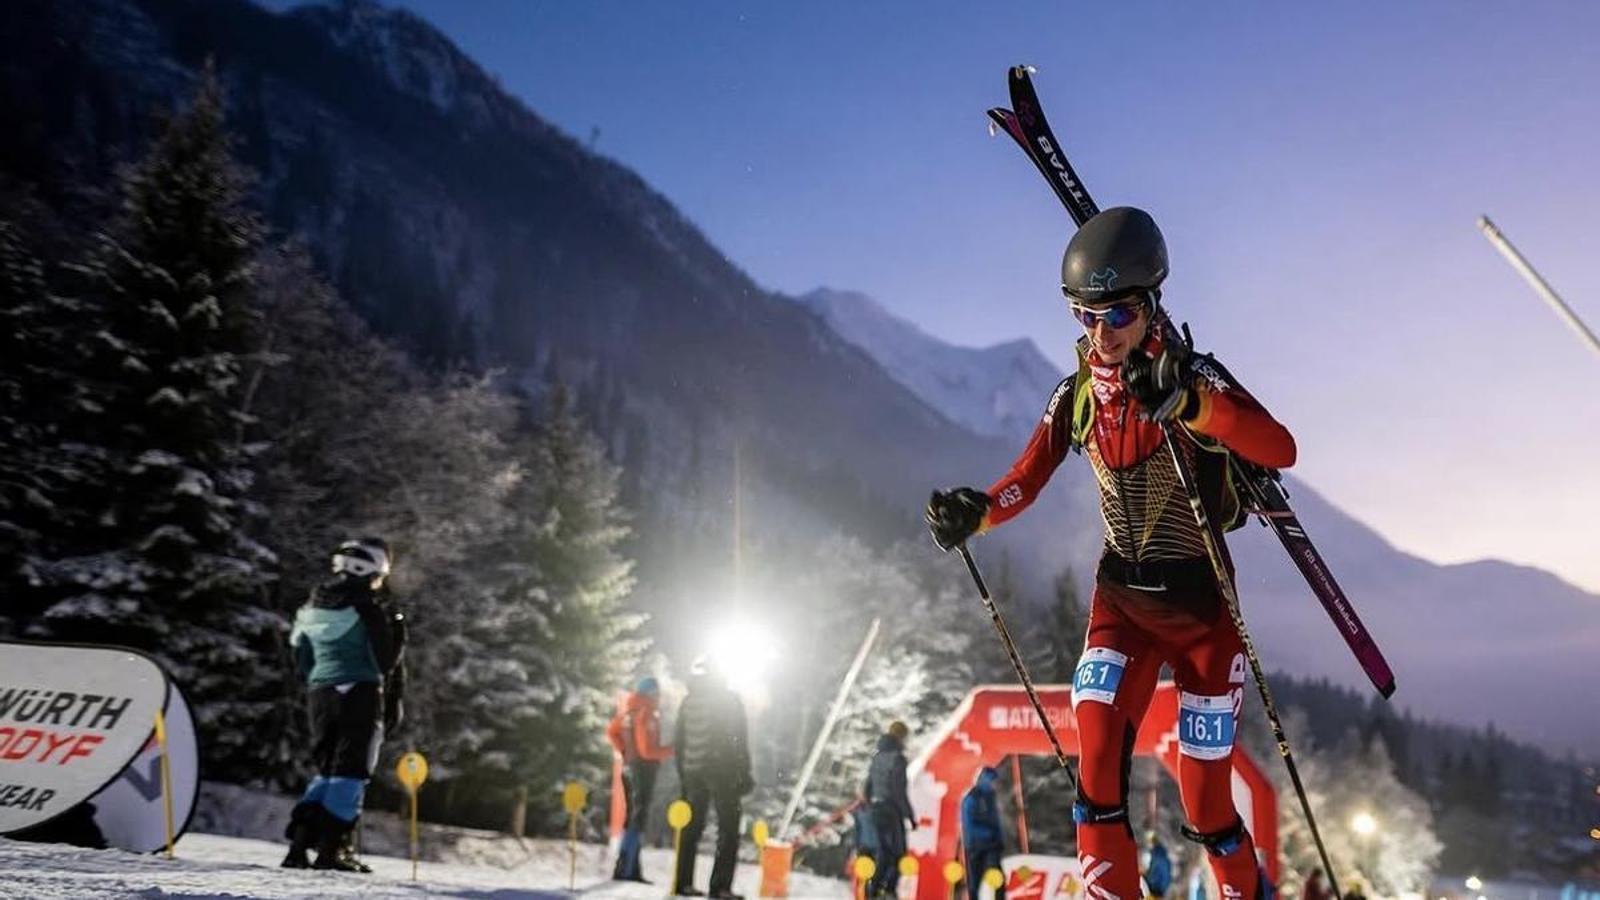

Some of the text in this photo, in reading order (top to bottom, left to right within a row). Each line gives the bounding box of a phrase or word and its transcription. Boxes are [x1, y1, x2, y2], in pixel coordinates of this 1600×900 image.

[999, 484, 1023, 508] ESP
[1076, 663, 1110, 689] 16.1
[0, 687, 133, 730] WÜRTH
[1186, 713, 1222, 741] 16.1
[0, 784, 56, 811] EAR
